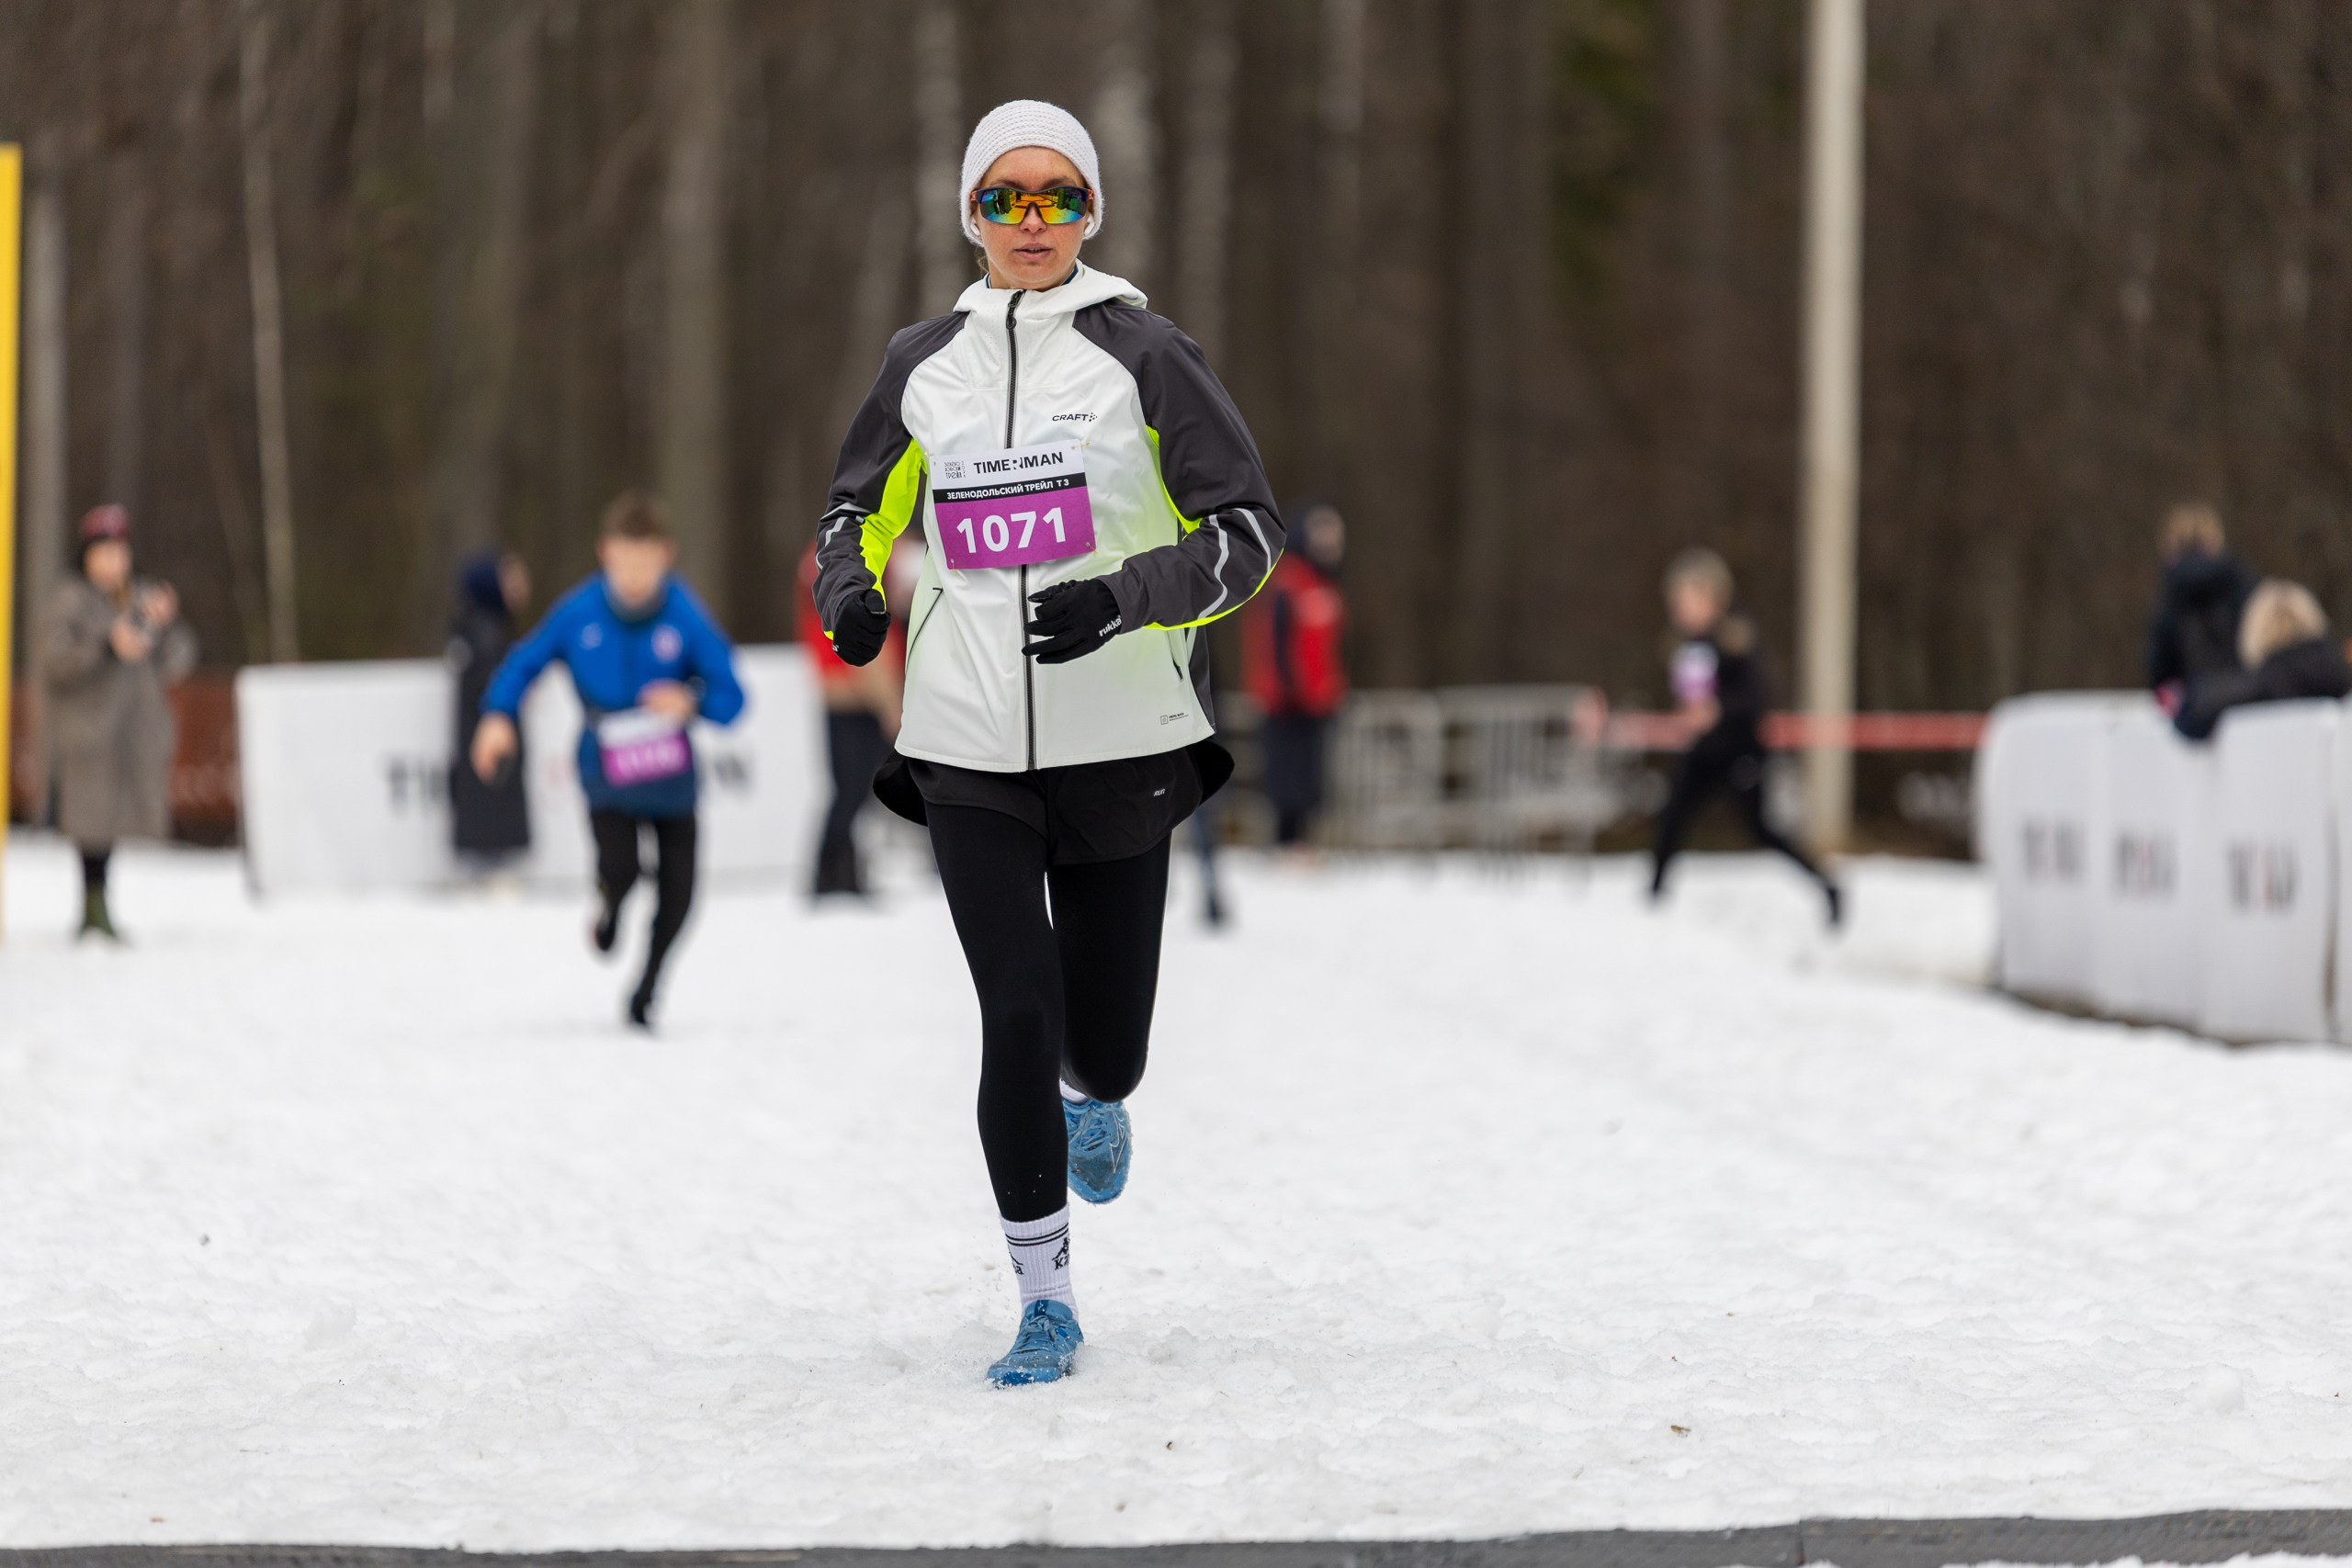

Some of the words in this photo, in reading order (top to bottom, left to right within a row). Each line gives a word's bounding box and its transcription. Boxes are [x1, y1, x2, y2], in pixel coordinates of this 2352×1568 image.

[1052, 413, 1089, 422] CRAFT
[946, 484, 1023, 500] ЗЕЛЕНОДОЛЬСКИЙ
[1024, 480, 1053, 492] ТРЕЙЛ
[956, 506, 1066, 554] 1071
[1099, 616, 1122, 637] rukka
